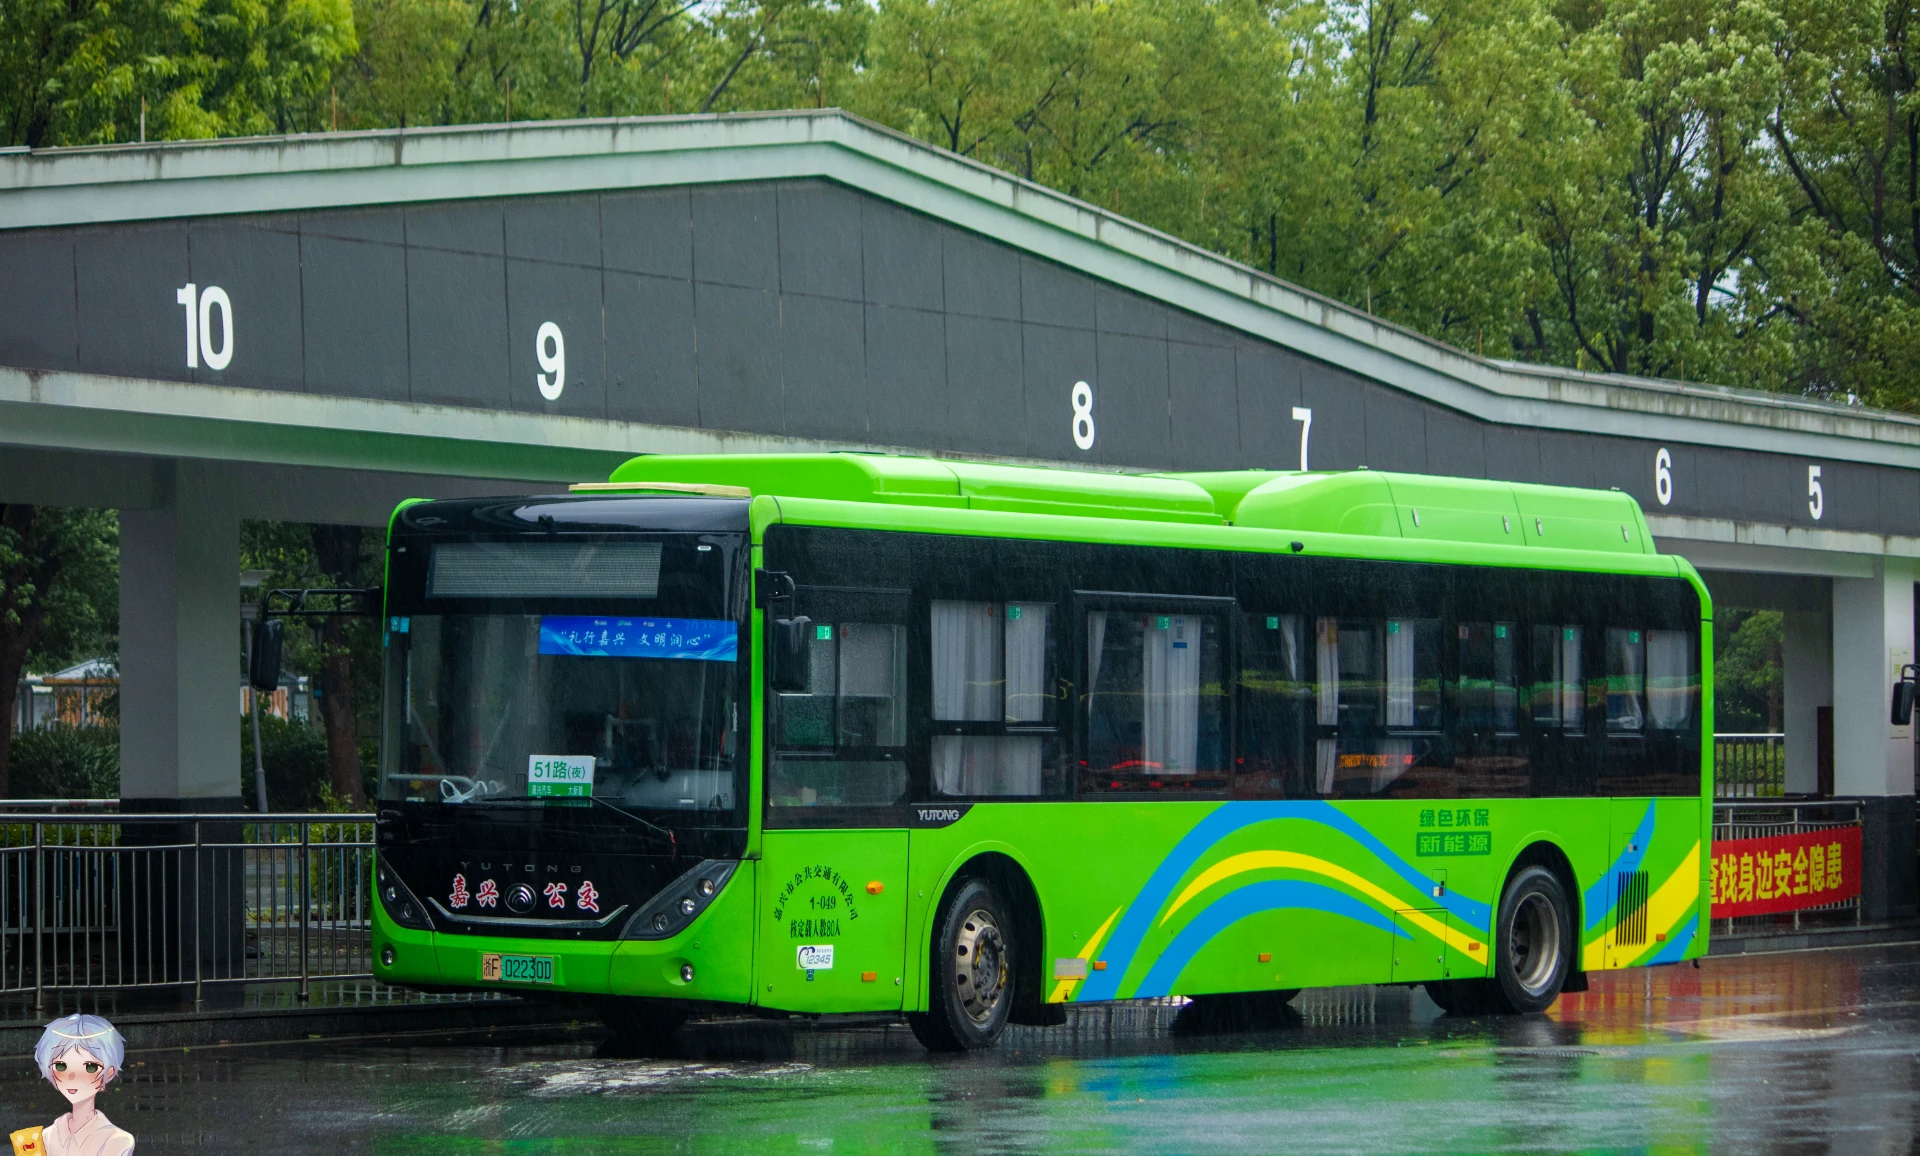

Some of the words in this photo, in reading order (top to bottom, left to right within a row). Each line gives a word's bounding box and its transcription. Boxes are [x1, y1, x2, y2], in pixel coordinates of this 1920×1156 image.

[176, 283, 234, 371] 10
[536, 321, 565, 401] 9
[1071, 381, 1095, 450] 8
[1292, 407, 1312, 471] 7
[1655, 448, 1673, 506] 6
[1808, 465, 1823, 520] 5
[534, 761, 586, 779] 51路(夜)
[917, 809, 960, 821] YUTONG
[1419, 808, 1490, 828] 绿色环保
[1420, 834, 1489, 853] 新能源
[461, 861, 582, 873] YUTONG
[449, 873, 499, 908] 嘉兴
[544, 880, 599, 912] 公交
[773, 864, 859, 922] 嘉兴市公共交通有限公司
[809, 896, 837, 910] 1-049
[806, 954, 831, 965] 12345
